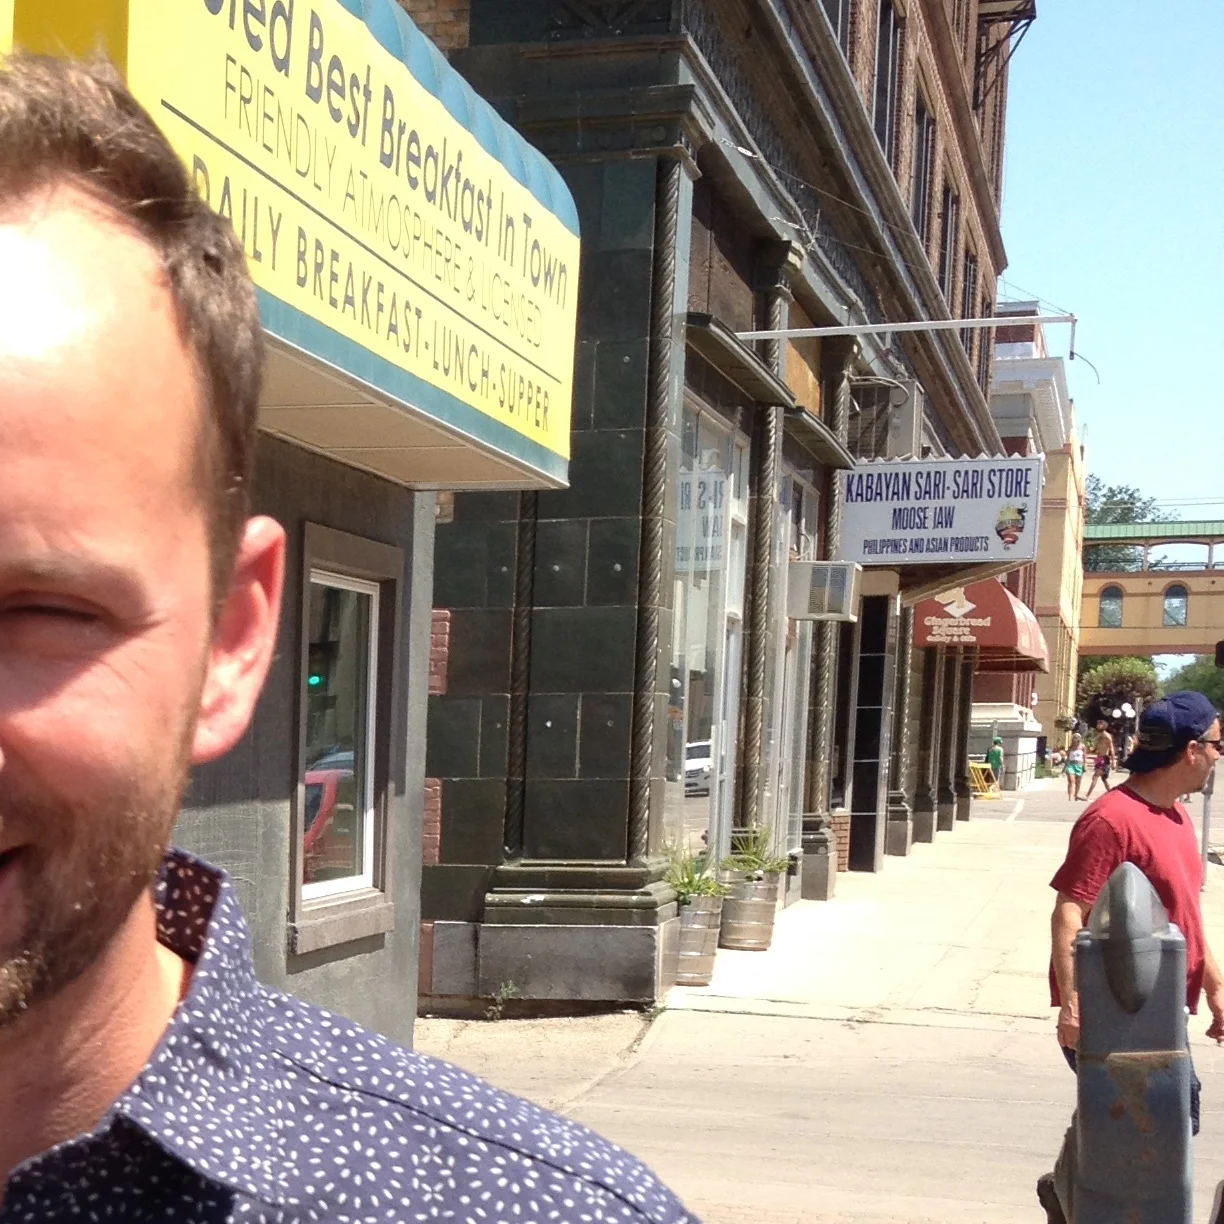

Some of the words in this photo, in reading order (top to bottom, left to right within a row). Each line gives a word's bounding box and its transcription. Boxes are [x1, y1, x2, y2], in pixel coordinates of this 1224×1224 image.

[305, 8, 373, 148] Best
[379, 84, 492, 248] Breakfast
[497, 191, 515, 267] In
[523, 212, 568, 311] Town
[224, 53, 337, 200] FRIENDLY
[342, 162, 462, 294] ATMOSPHERE
[466, 256, 476, 303] &
[481, 260, 542, 348] LICENSED
[845, 472, 912, 503] KABAYAN
[987, 467, 1032, 498] STORE
[891, 506, 929, 531] MOOSE
[862, 537, 907, 555] PHILIPPINES
[909, 537, 924, 553] AND
[926, 536, 949, 553] ASIAN
[950, 535, 990, 553] PRODUCTS
